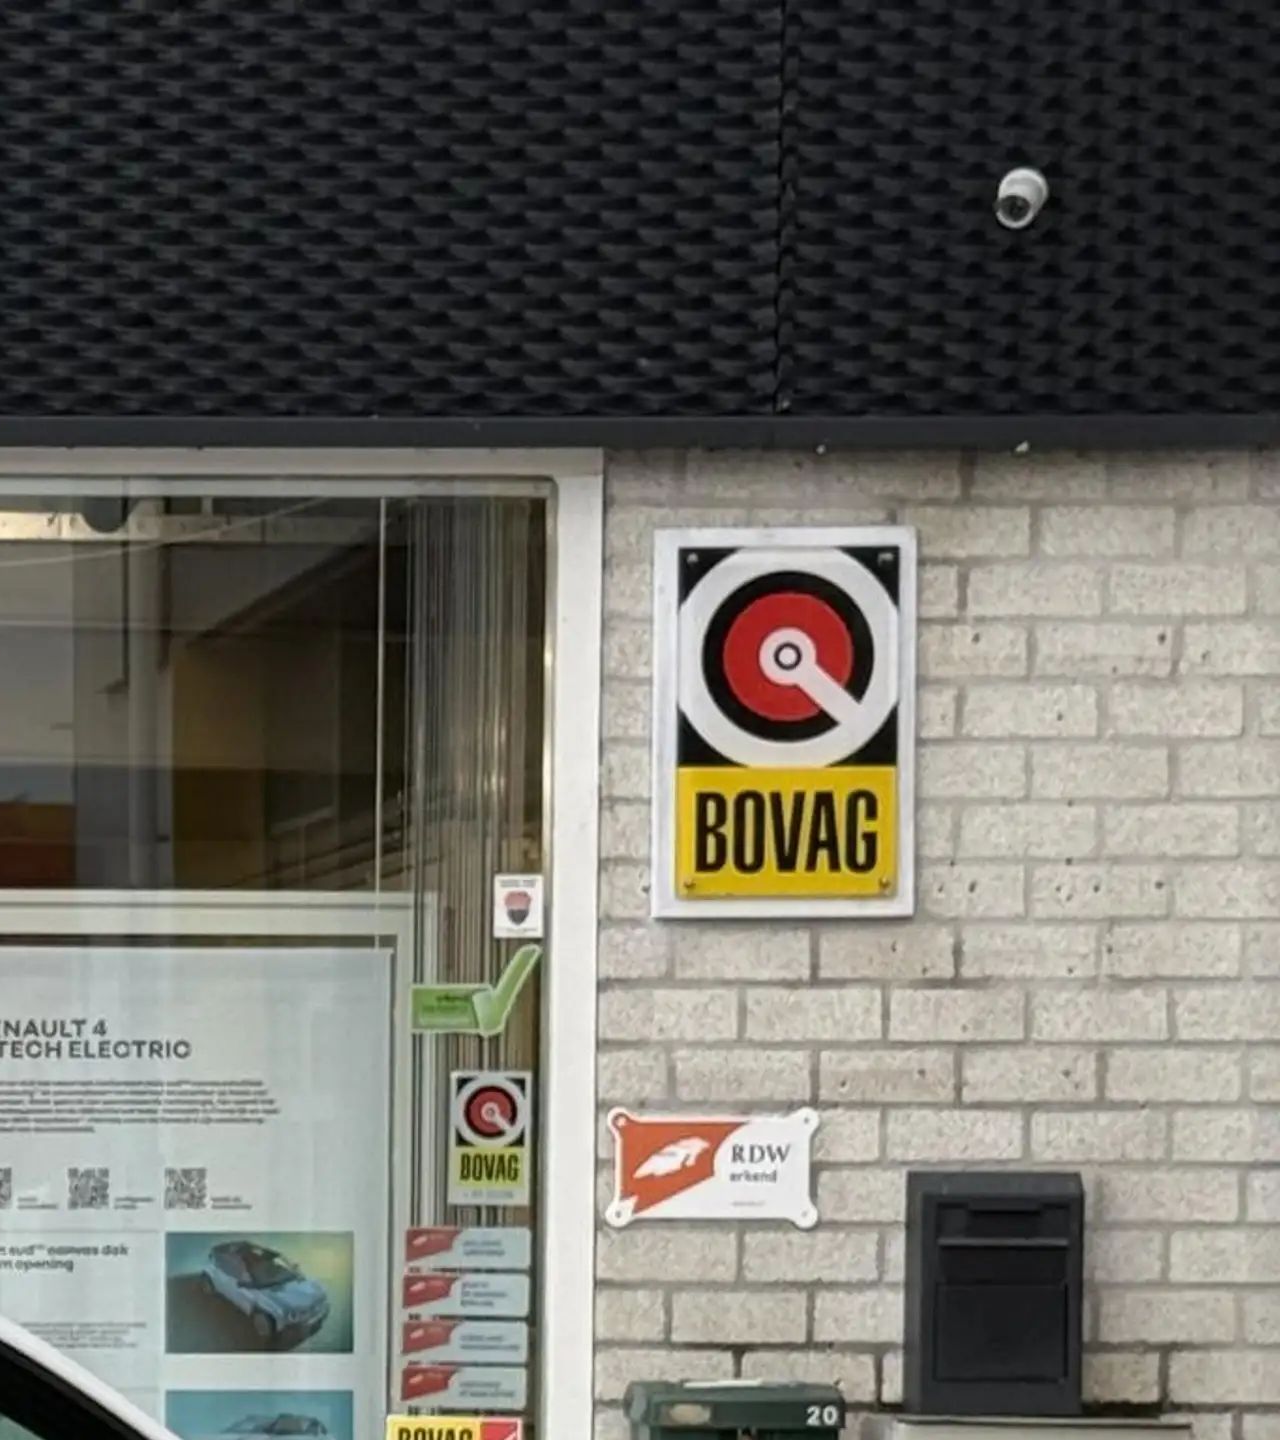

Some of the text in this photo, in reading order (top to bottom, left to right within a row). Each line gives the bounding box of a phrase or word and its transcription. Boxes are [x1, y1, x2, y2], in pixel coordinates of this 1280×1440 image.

[695, 789, 879, 874] BOVAG
[91, 1019, 108, 1038] 4
[69, 1040, 193, 1060] ELECTRIC
[730, 1143, 791, 1164] RDW
[459, 1153, 520, 1182] BOVAG
[729, 1169, 777, 1184] erkend
[806, 1405, 838, 1427] 20
